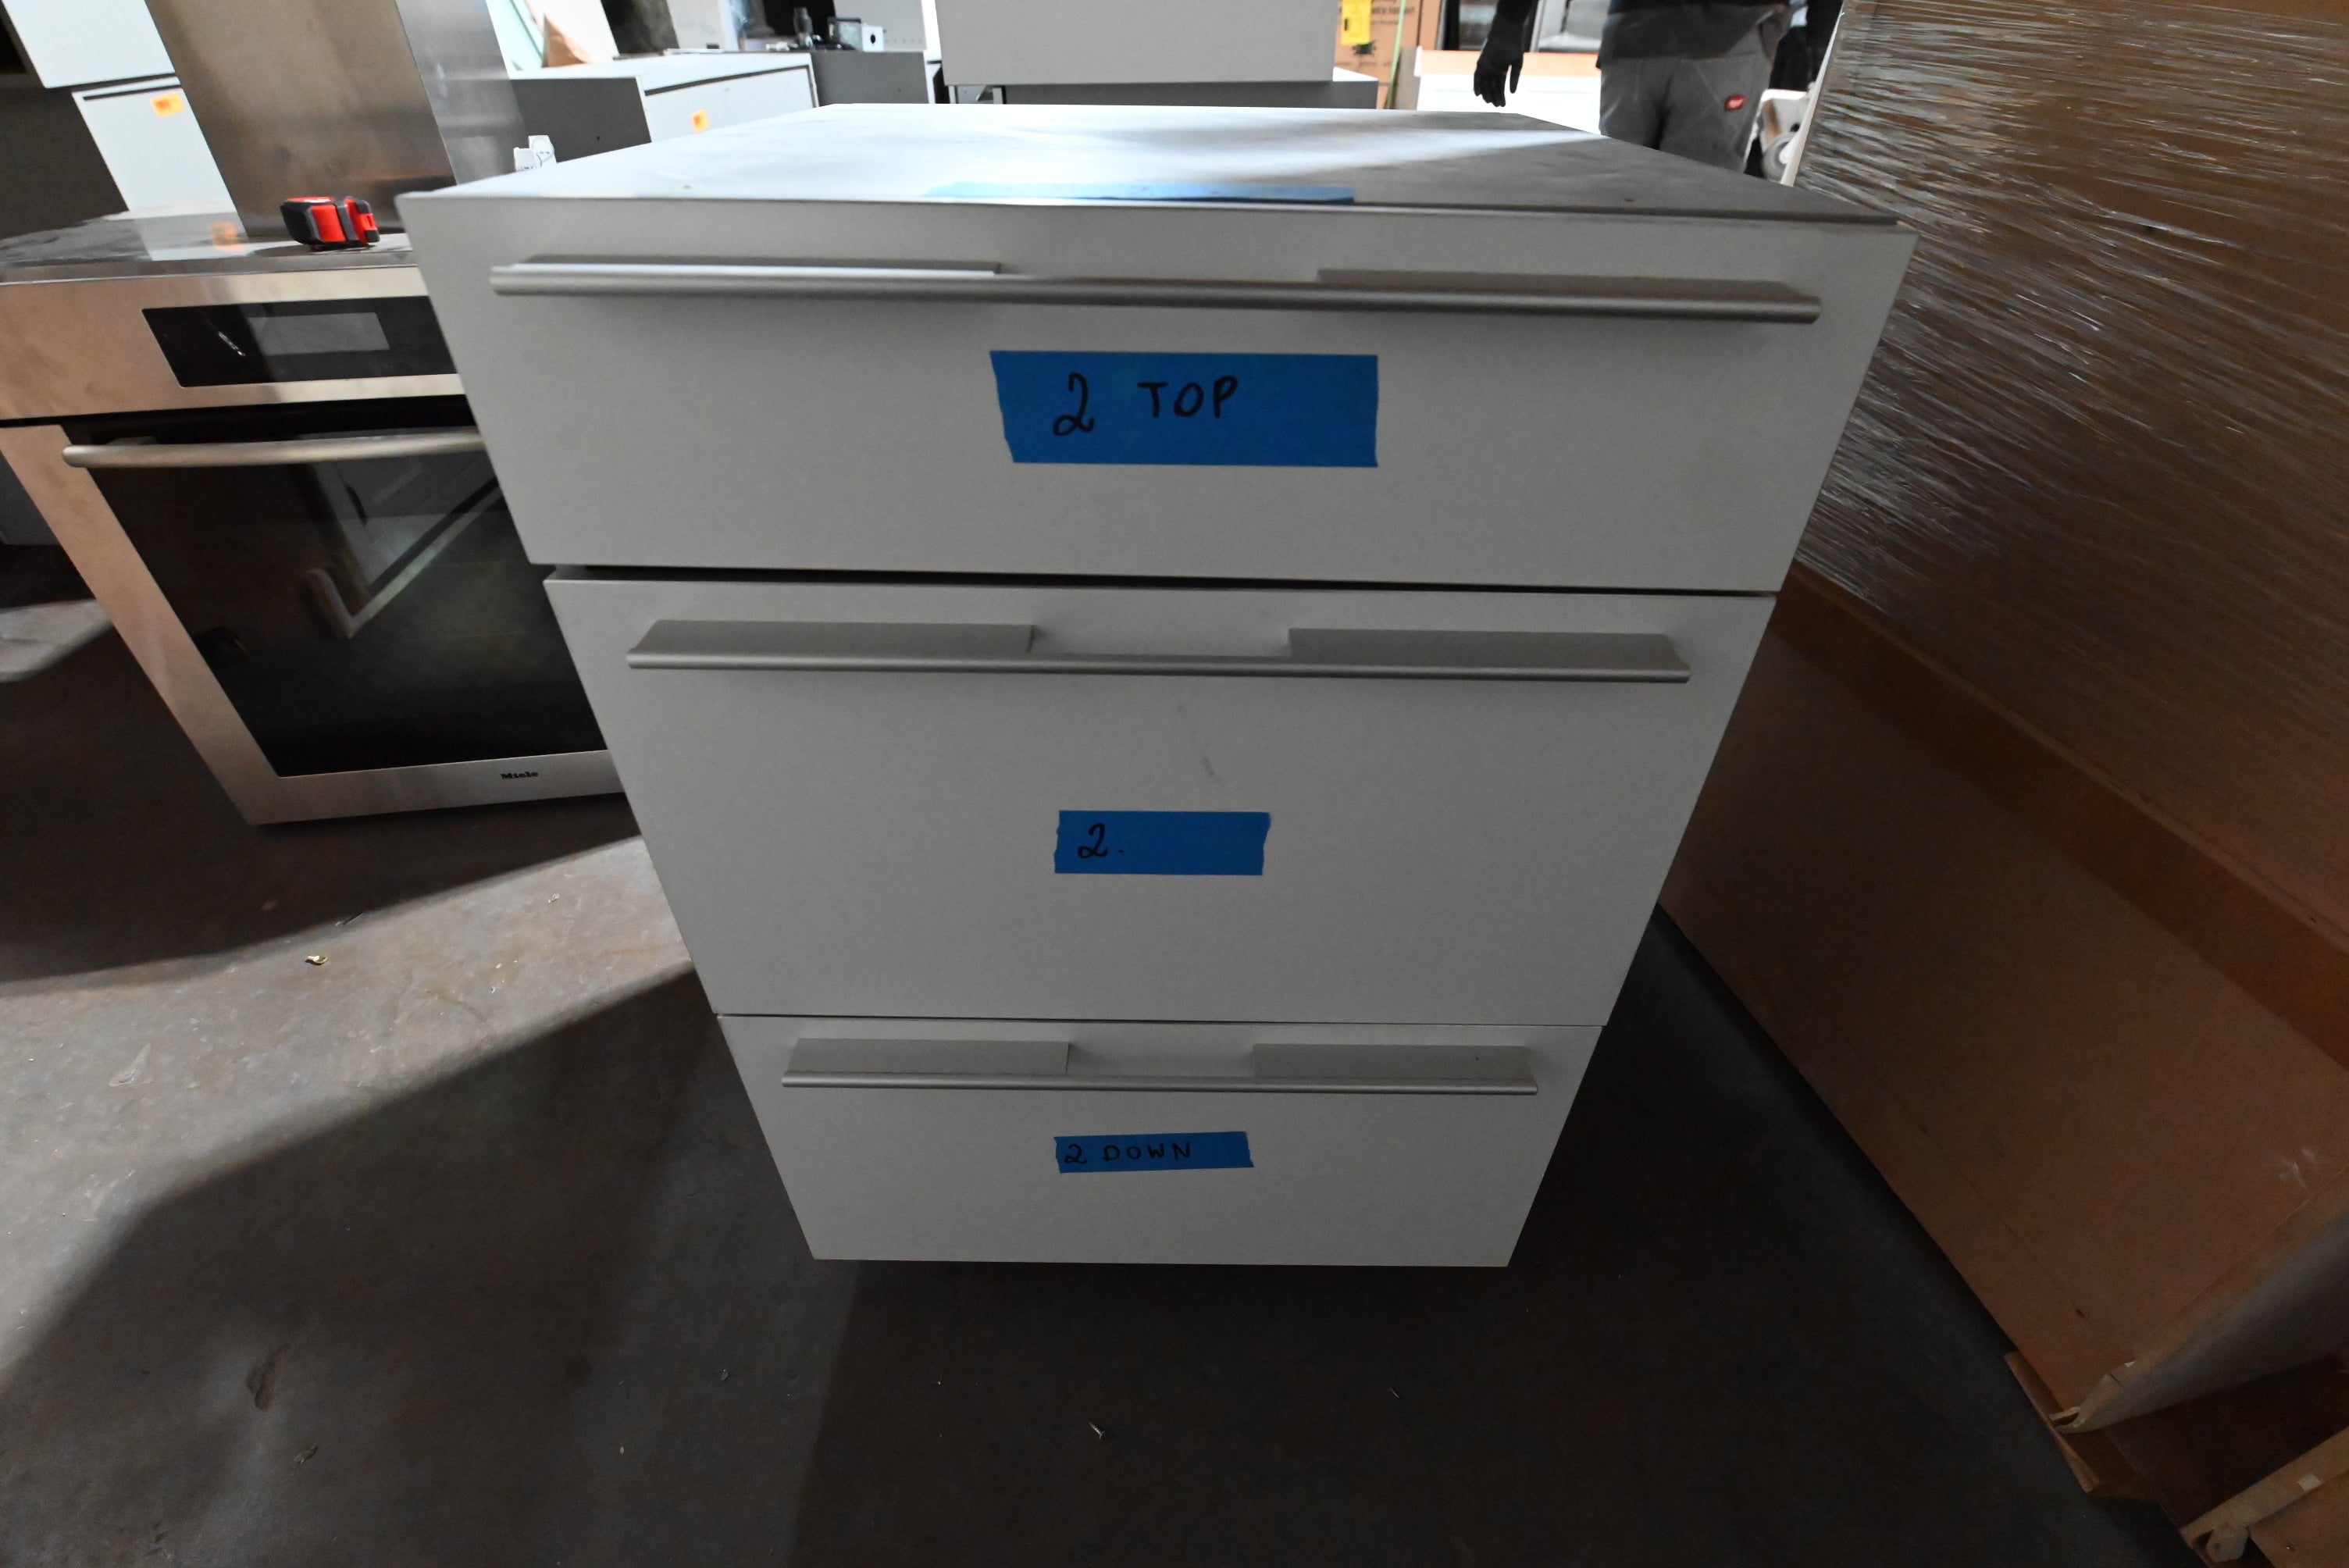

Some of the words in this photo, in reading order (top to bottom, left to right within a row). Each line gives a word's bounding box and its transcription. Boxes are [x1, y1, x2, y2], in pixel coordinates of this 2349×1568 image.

[1052, 372, 1095, 437] 2
[1136, 374, 1239, 419] TOP
[500, 772, 540, 780] Miele
[1063, 1142, 1088, 1165] 2
[1102, 1140, 1192, 1163] DOWN
